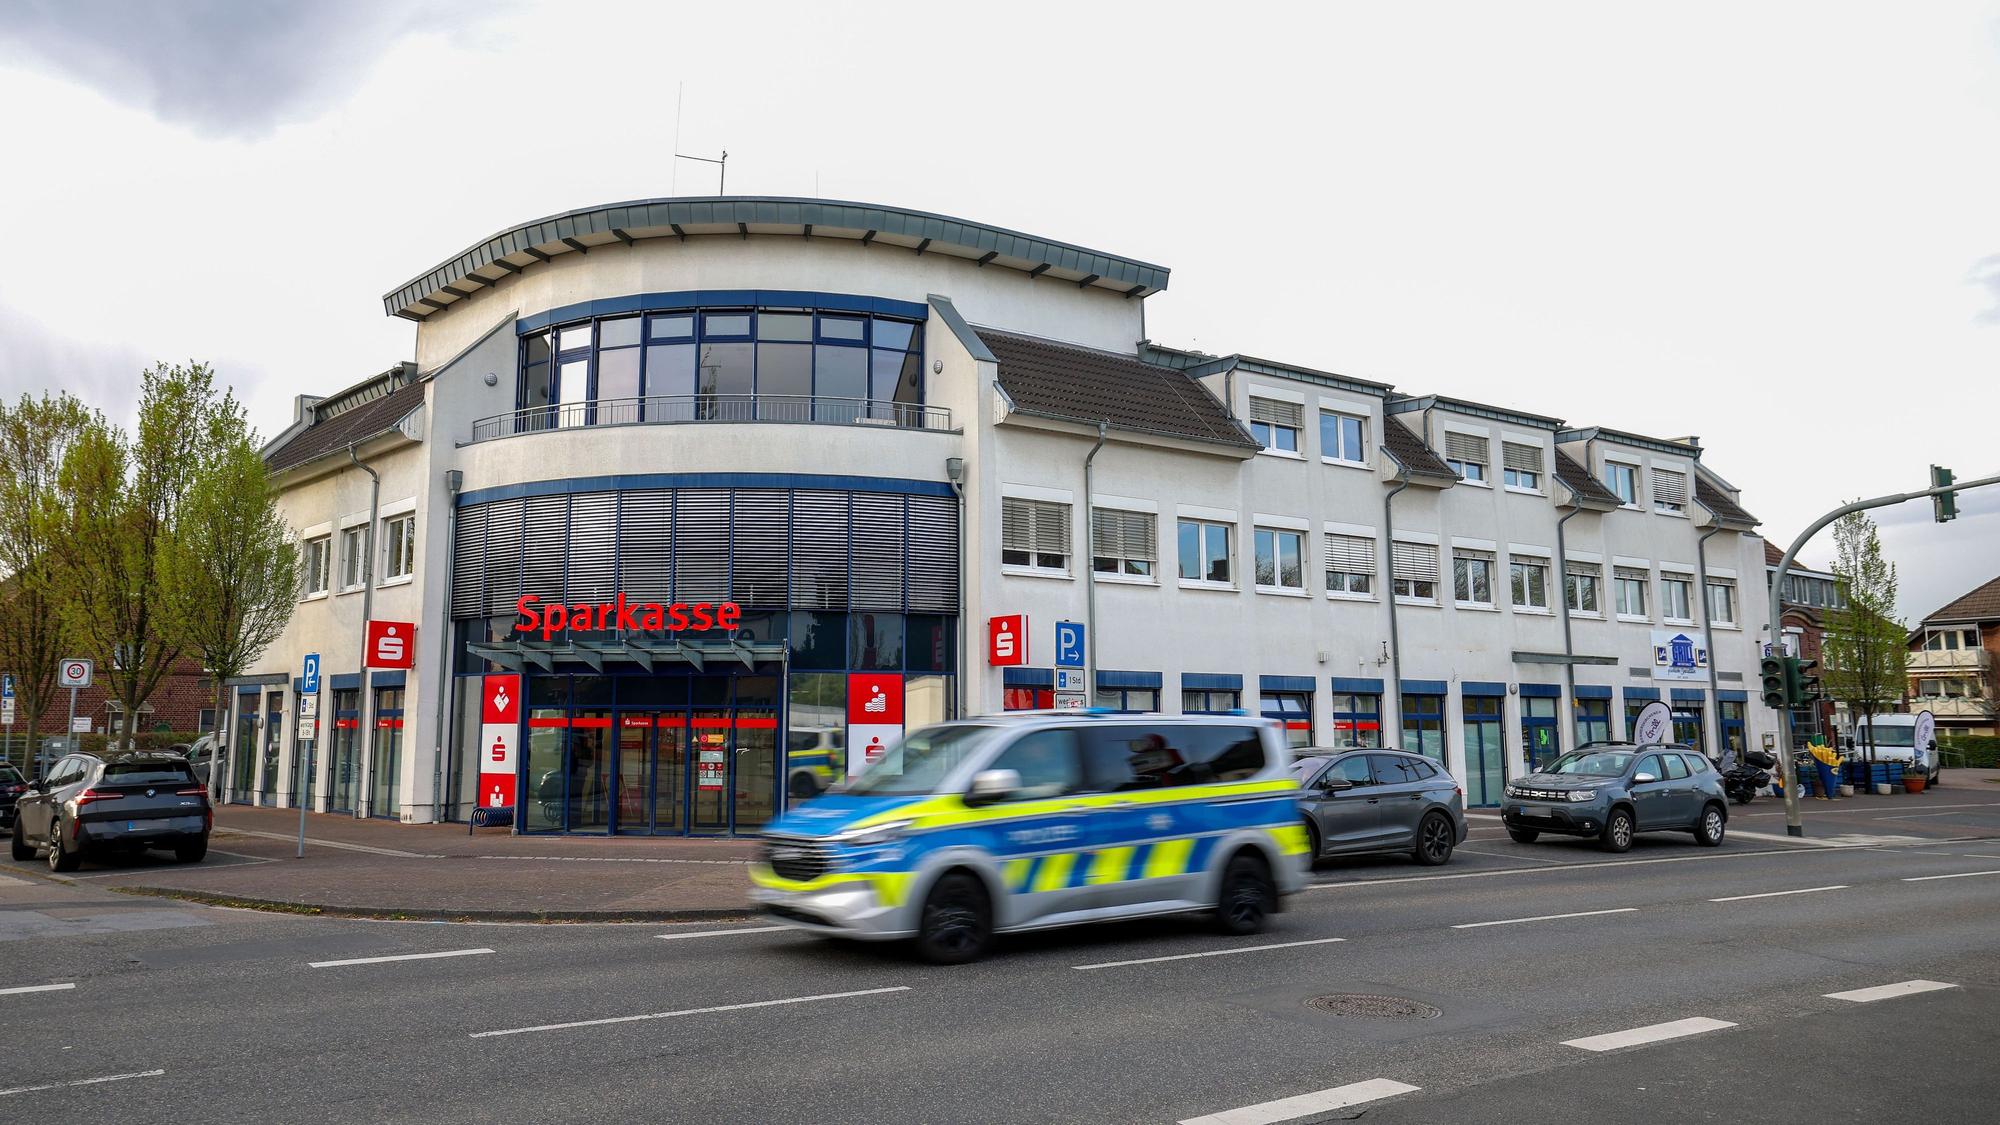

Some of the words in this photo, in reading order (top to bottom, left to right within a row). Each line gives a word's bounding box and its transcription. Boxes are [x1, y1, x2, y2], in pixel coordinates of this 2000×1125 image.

[515, 592, 742, 641] Sparkasse
[1060, 627, 1076, 661] P
[1673, 644, 1693, 662] GRILL
[71, 667, 80, 675] 30
[305, 658, 316, 689] P
[1645, 718, 1661, 739] Grill
